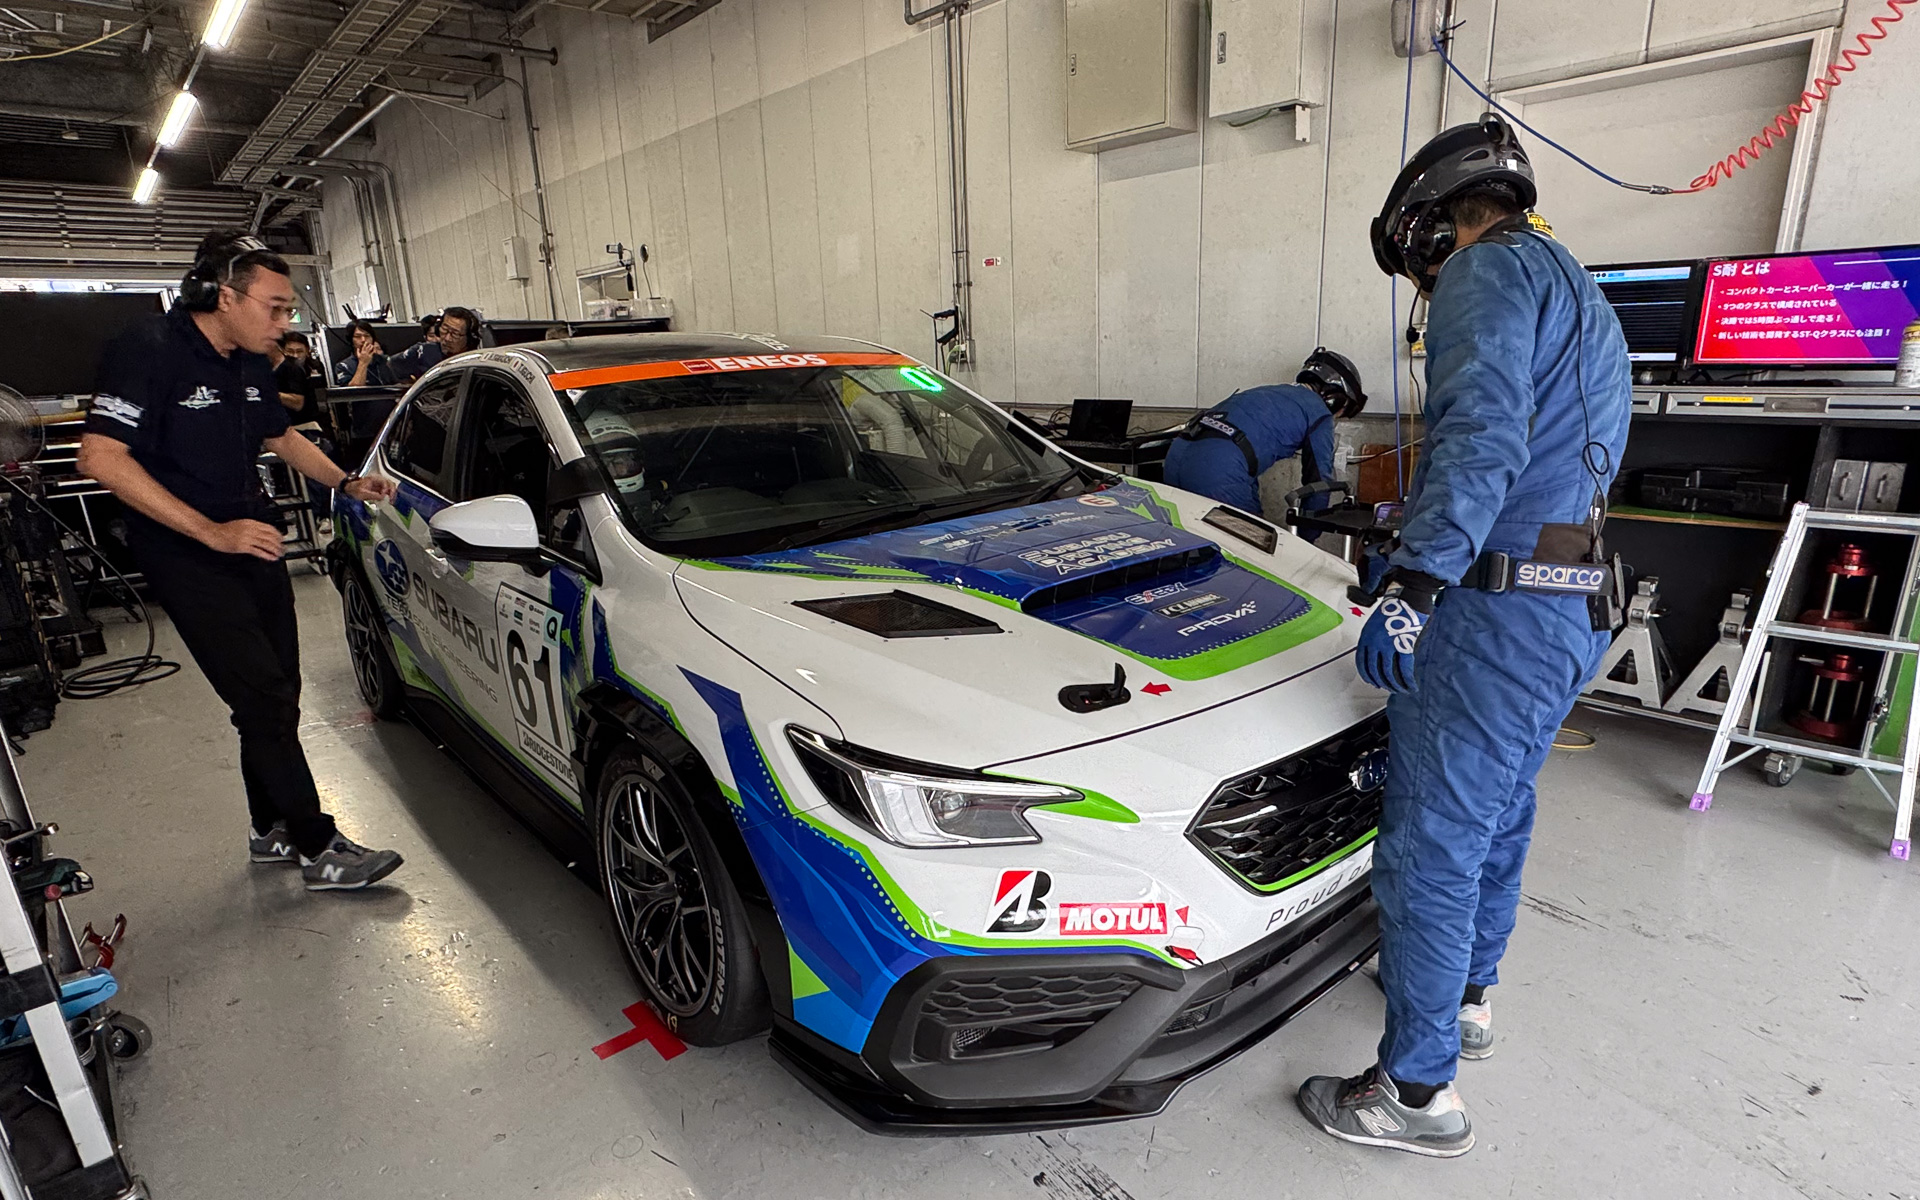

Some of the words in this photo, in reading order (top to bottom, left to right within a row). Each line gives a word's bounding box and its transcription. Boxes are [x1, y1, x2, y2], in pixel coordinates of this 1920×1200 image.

[1741, 261, 1771, 275] とは
[710, 354, 828, 370] ENEOS
[1202, 416, 1235, 435] sparco
[1018, 532, 1131, 562] SUBARU
[1031, 536, 1150, 567] DRIVING
[1056, 538, 1177, 576] ACADEMY
[1517, 563, 1604, 587] sparco
[413, 571, 499, 675] SUBARU
[547, 616, 558, 641] Q
[1177, 607, 1257, 637] PROVA
[431, 630, 499, 704] ENGINEERING
[507, 629, 564, 751] 61
[522, 731, 576, 784] BRIDGESTONE
[321, 864, 344, 882] N
[1265, 873, 1344, 932] Proud
[1064, 905, 1164, 931] MOTUL
[711, 906, 726, 1016] POTENZA
[1355, 1106, 1400, 1136] N
